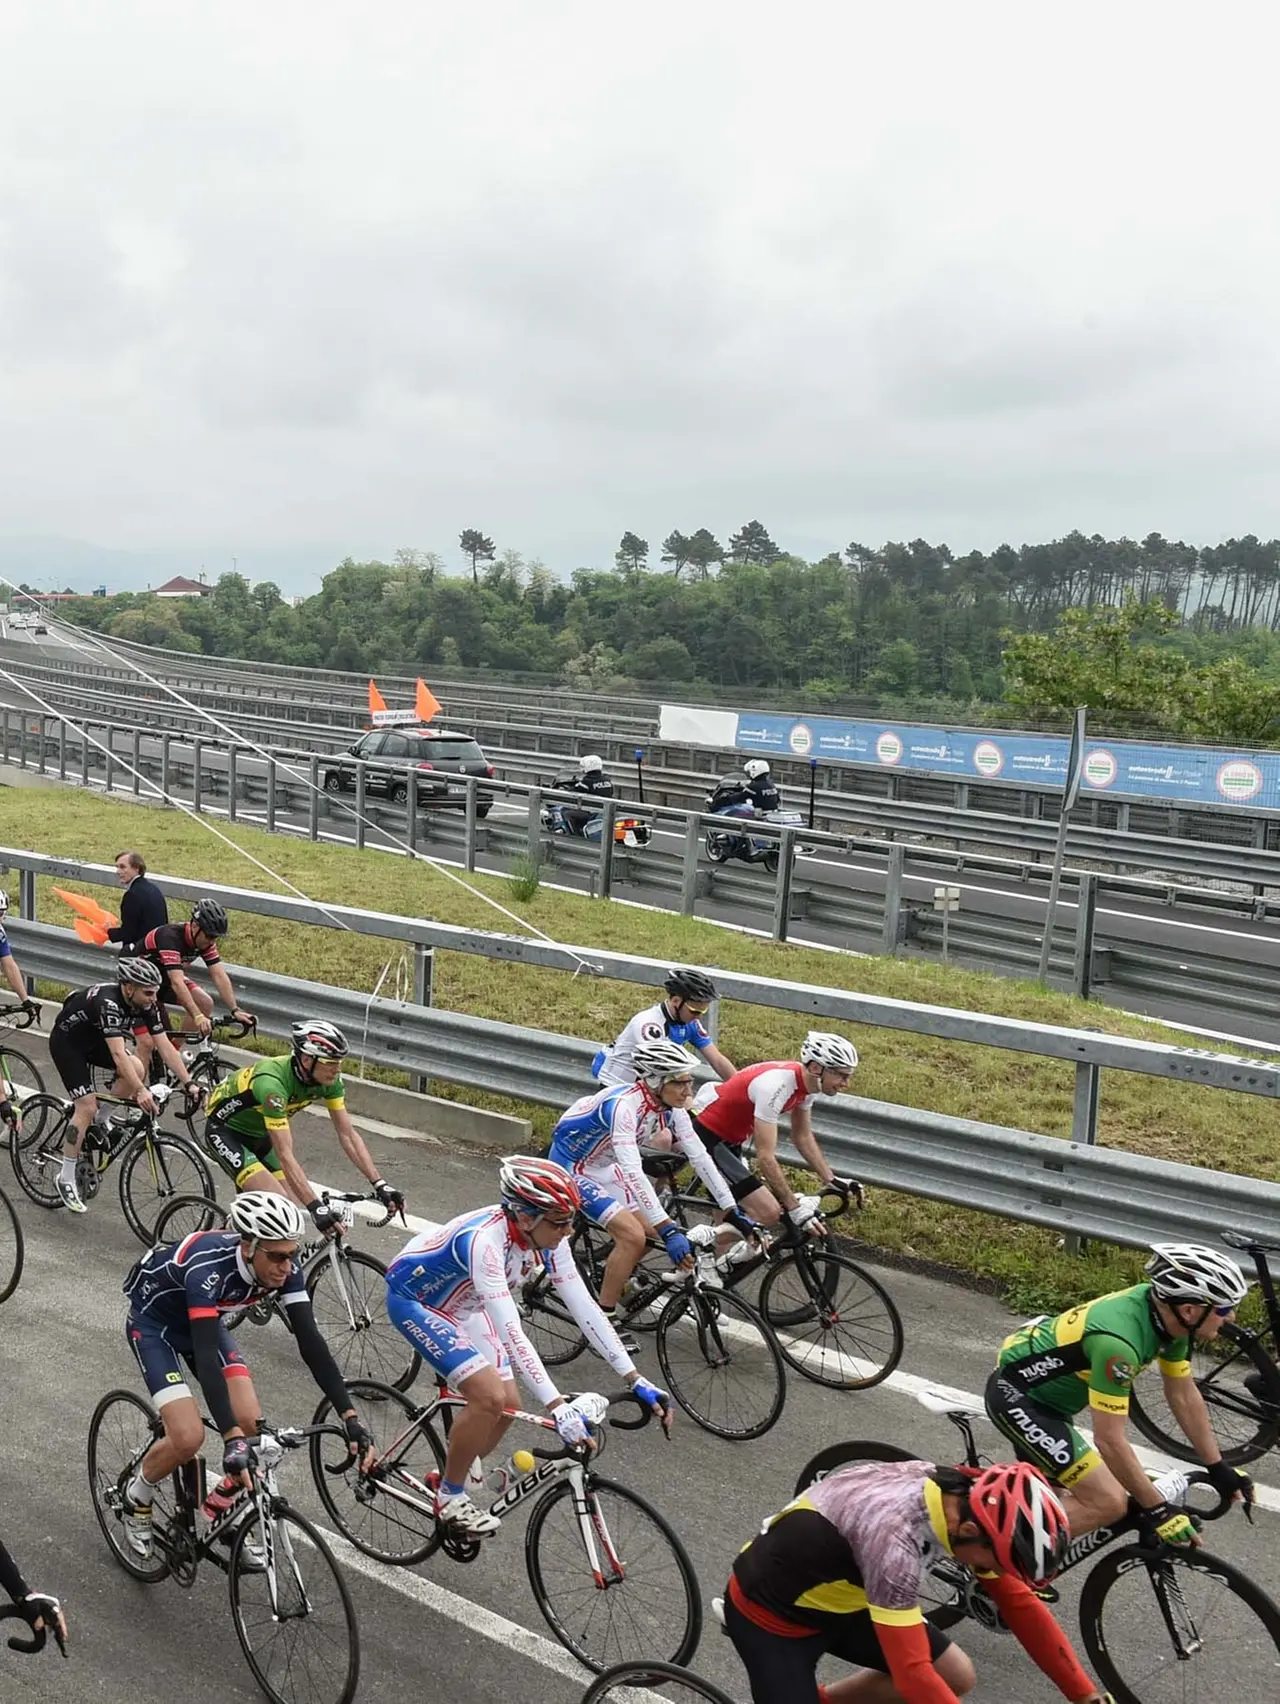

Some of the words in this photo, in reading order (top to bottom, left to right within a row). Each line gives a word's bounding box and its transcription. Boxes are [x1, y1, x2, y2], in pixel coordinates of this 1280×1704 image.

[201, 1270, 220, 1292] UCS
[402, 1319, 446, 1360] FIRENZE
[522, 1356, 545, 1385] FUOCO
[1008, 1406, 1071, 1465] mugello
[489, 1462, 558, 1517] CUBE
